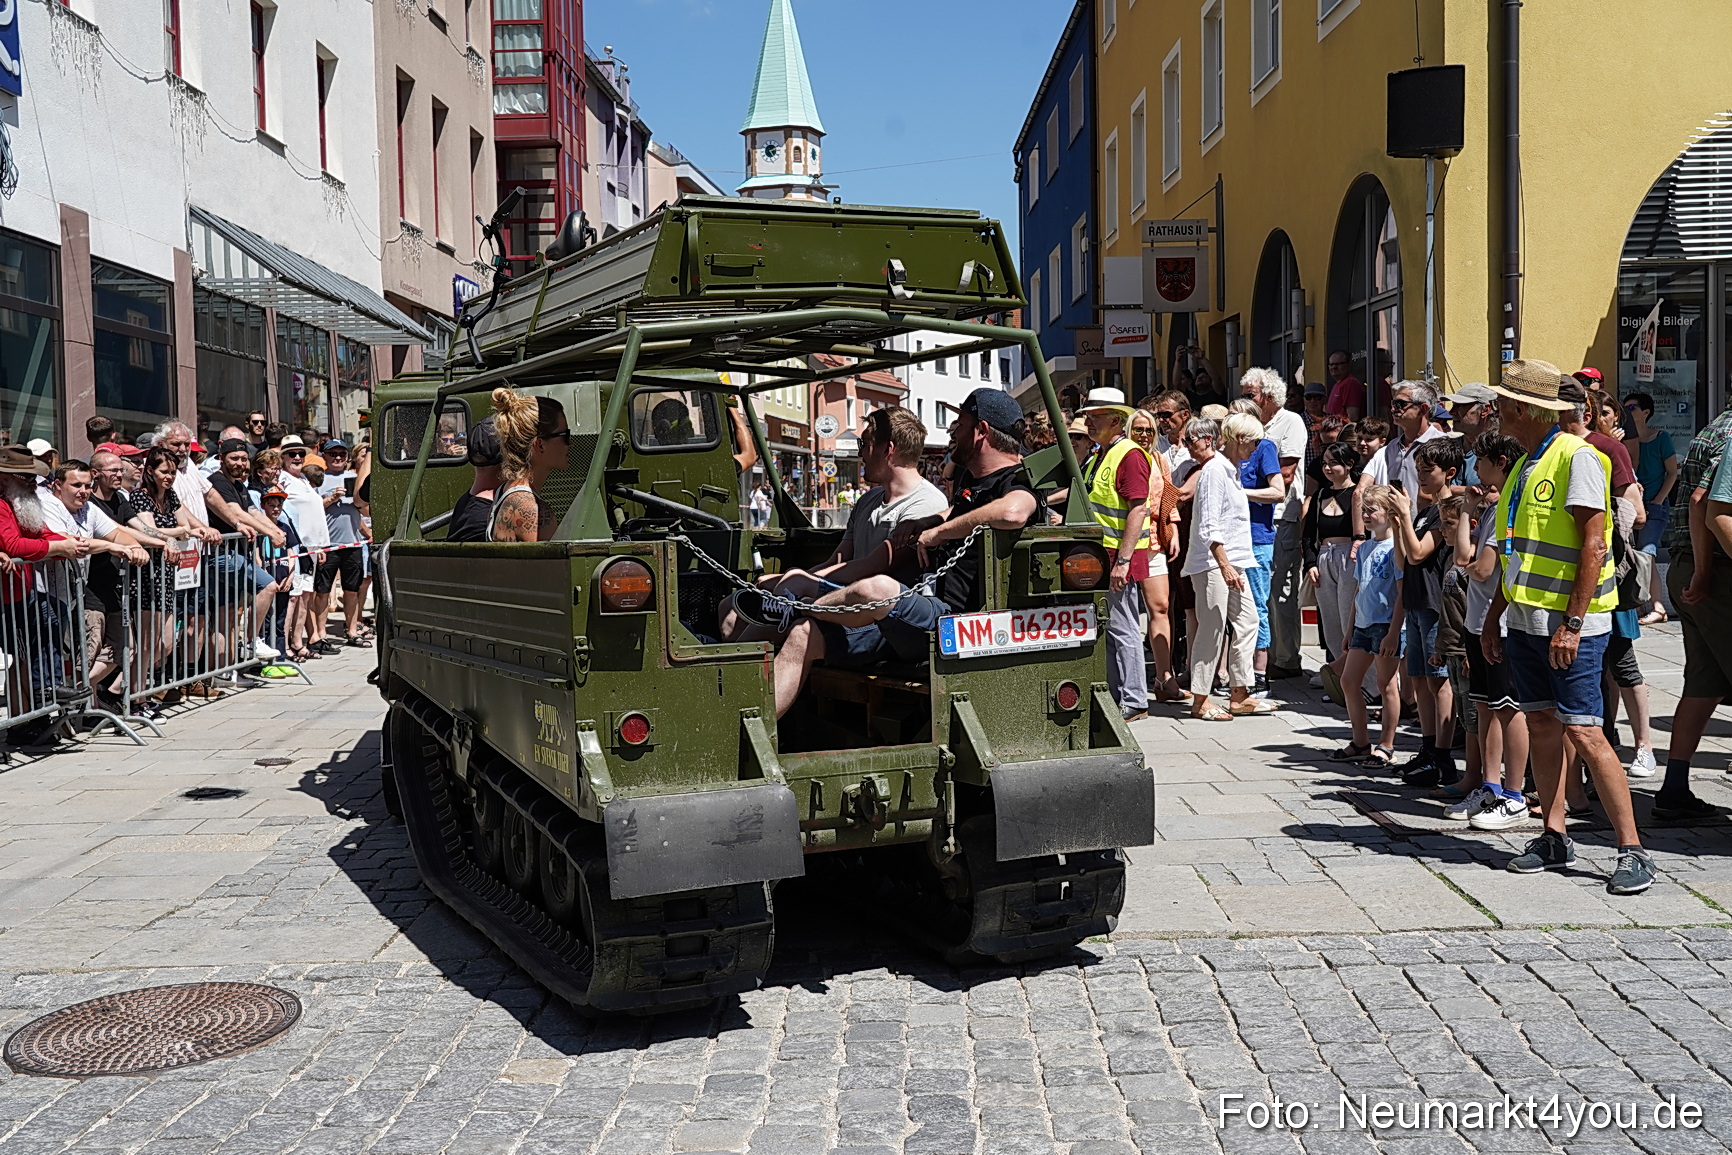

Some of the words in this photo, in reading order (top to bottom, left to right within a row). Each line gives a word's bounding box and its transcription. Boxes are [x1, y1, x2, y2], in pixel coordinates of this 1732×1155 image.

[1148, 224, 1194, 237] RATHAUS
[1195, 224, 1202, 236] II
[1663, 316, 1695, 326] Bilder
[1639, 364, 1652, 374] BILDER
[1652, 389, 1668, 398] Baby
[1678, 402, 1687, 413] P
[945, 638, 952, 648] D
[957, 617, 993, 648] NM
[1011, 609, 1088, 643] 06285
[534, 743, 541, 763] EN
[541, 746, 557, 769] SVENSK
[557, 751, 570, 774] TIGER
